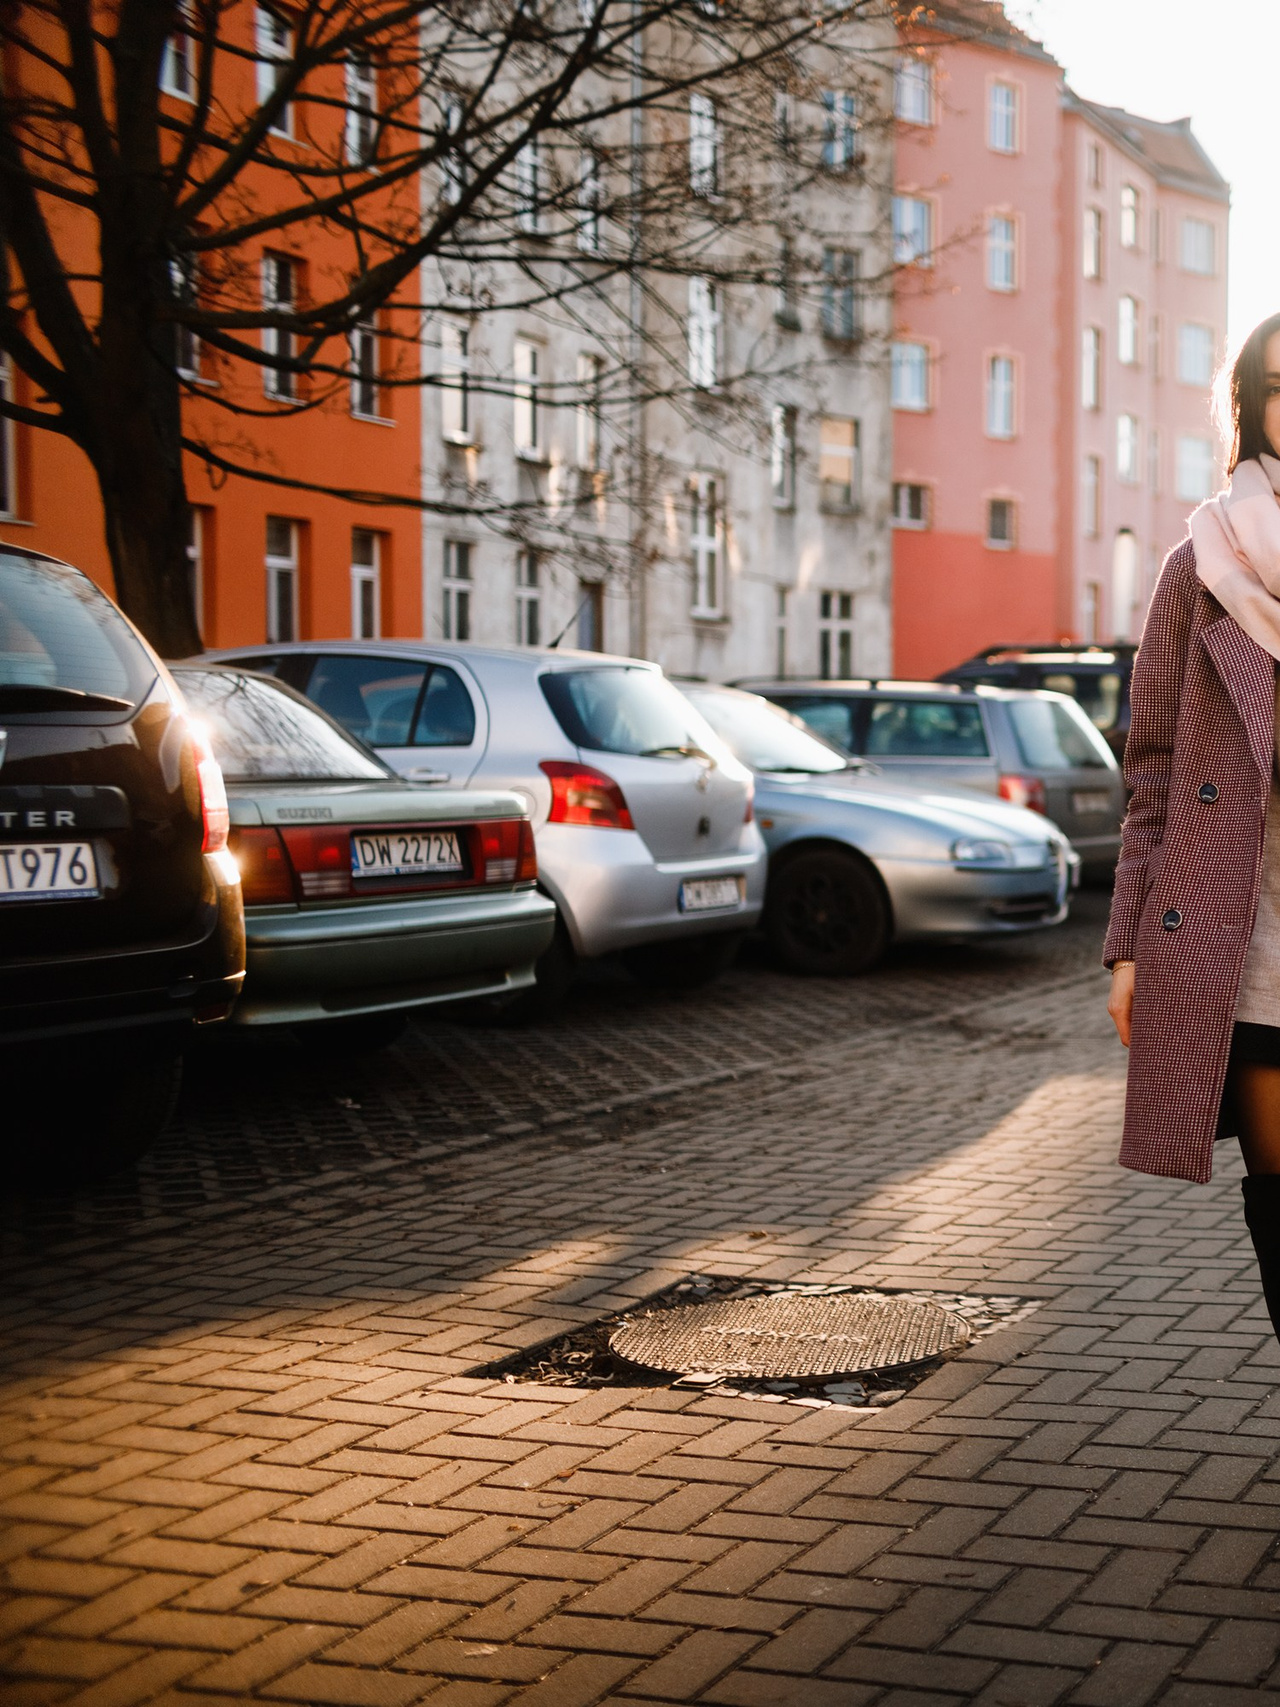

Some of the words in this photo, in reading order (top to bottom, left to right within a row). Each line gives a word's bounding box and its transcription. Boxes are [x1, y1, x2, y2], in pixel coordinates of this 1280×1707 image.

[0, 810, 76, 828] TER
[277, 806, 333, 820] SUZUKI
[360, 838, 392, 866] DW
[398, 833, 459, 864] 2272X
